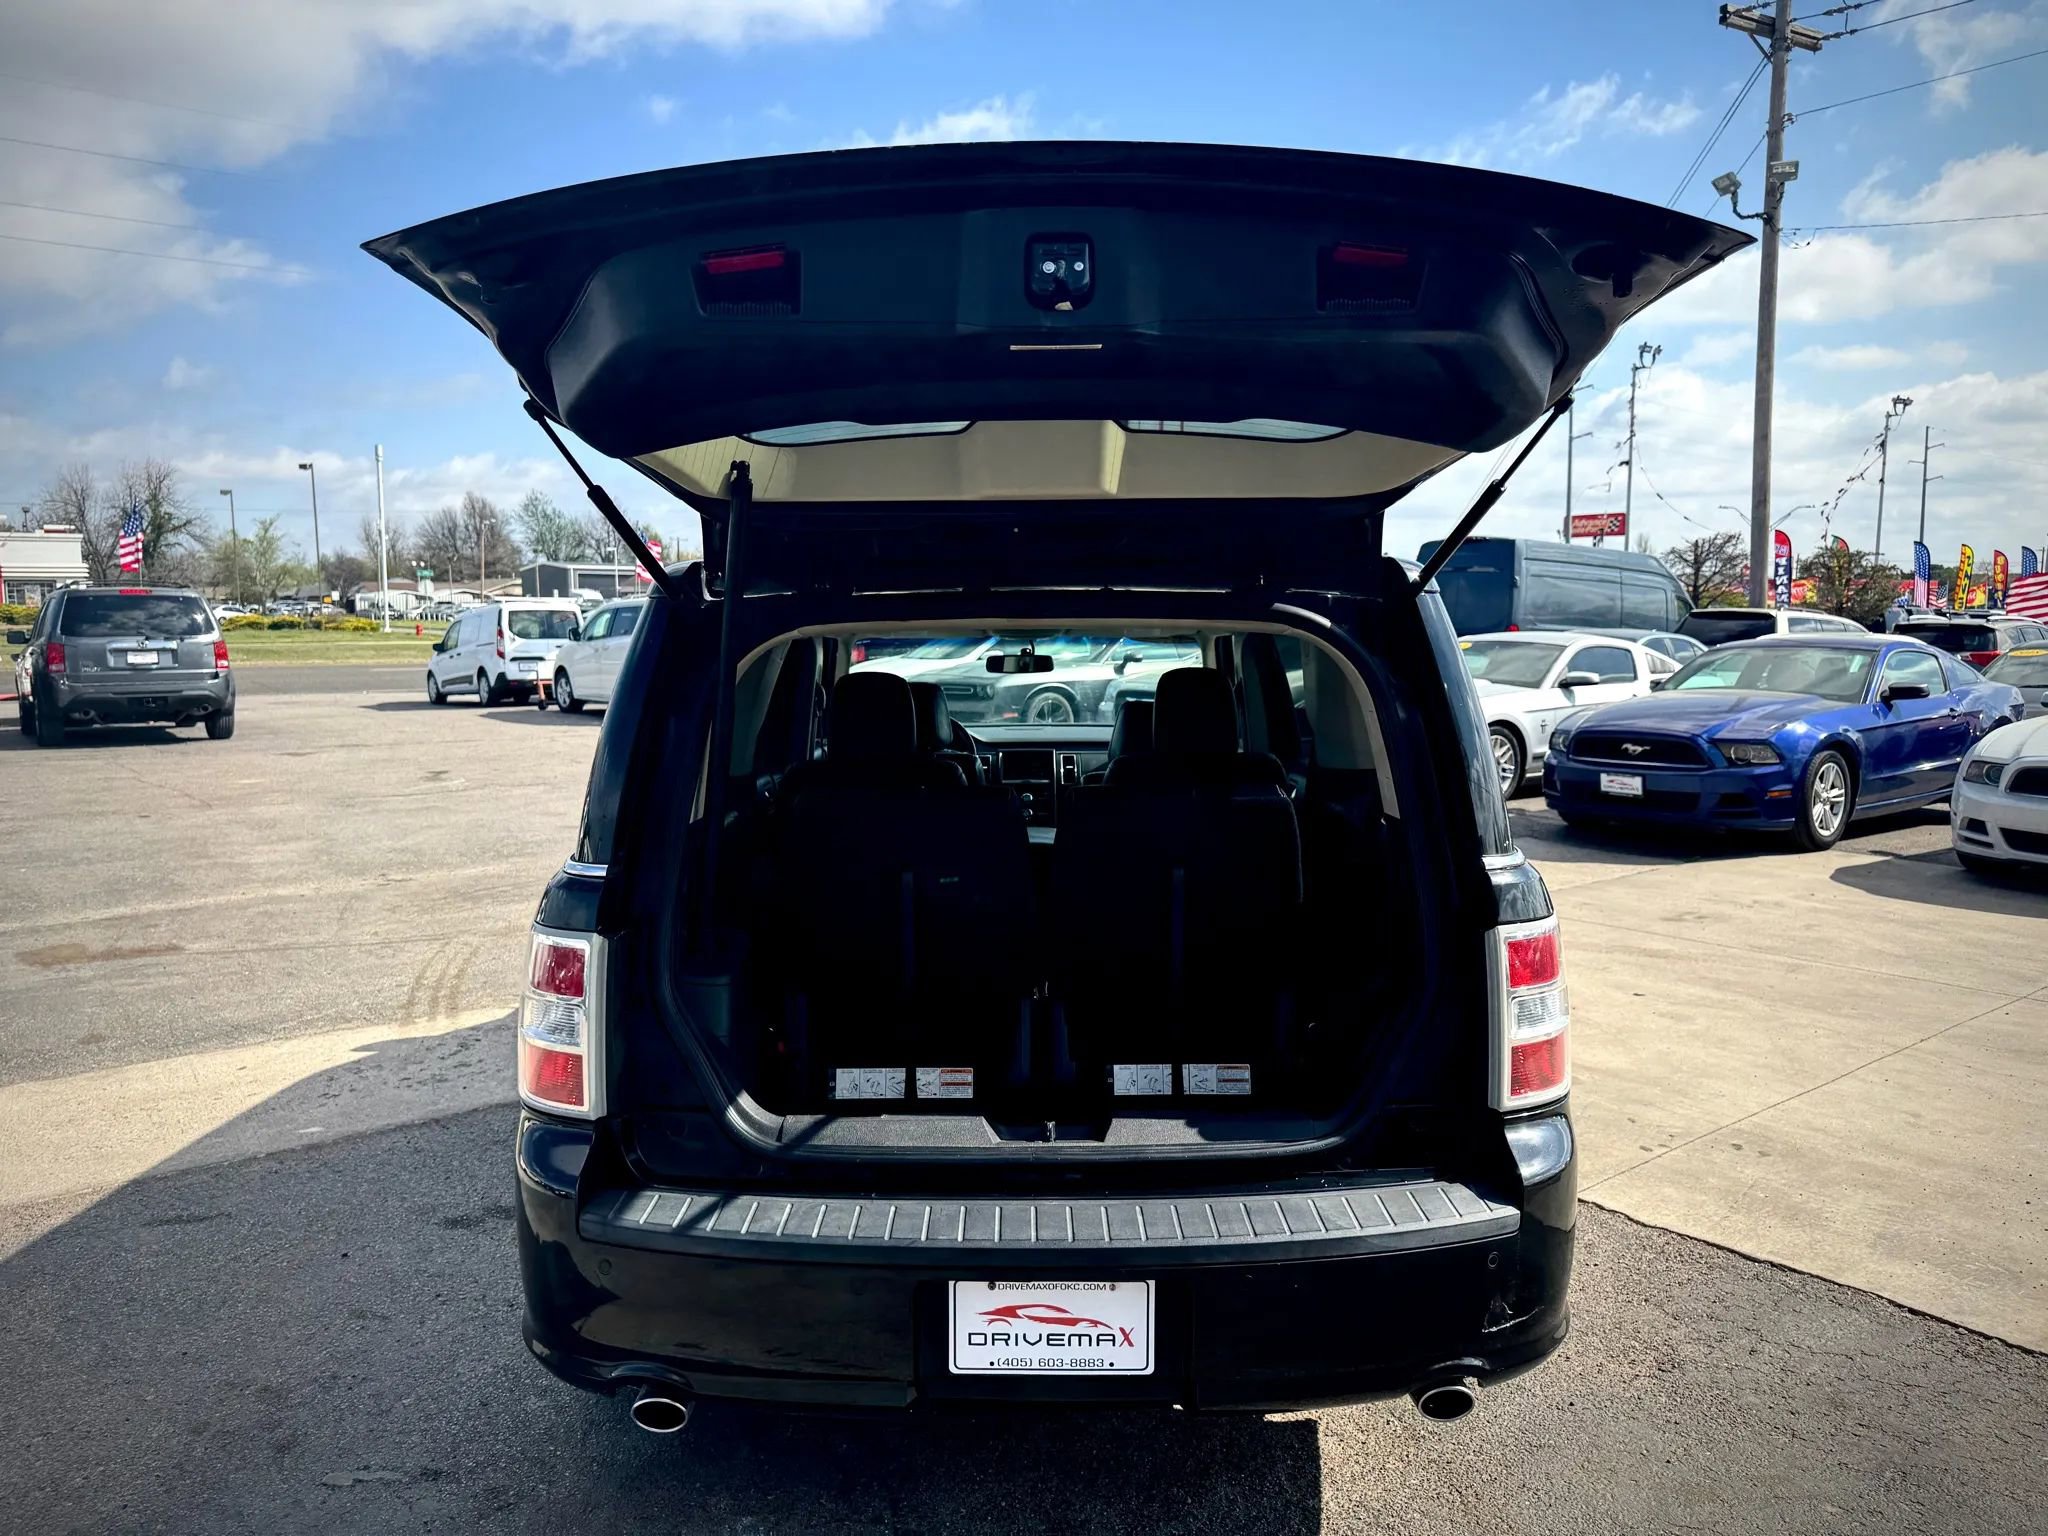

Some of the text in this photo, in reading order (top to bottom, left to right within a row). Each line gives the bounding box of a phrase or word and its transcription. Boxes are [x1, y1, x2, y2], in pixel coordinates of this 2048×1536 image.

[998, 1282, 1107, 1291] DRIVEMAXOFOKC.COM
[968, 1327, 1135, 1347] DRIVEMAX
[997, 1357, 1105, 1368] (405) 603-8883
